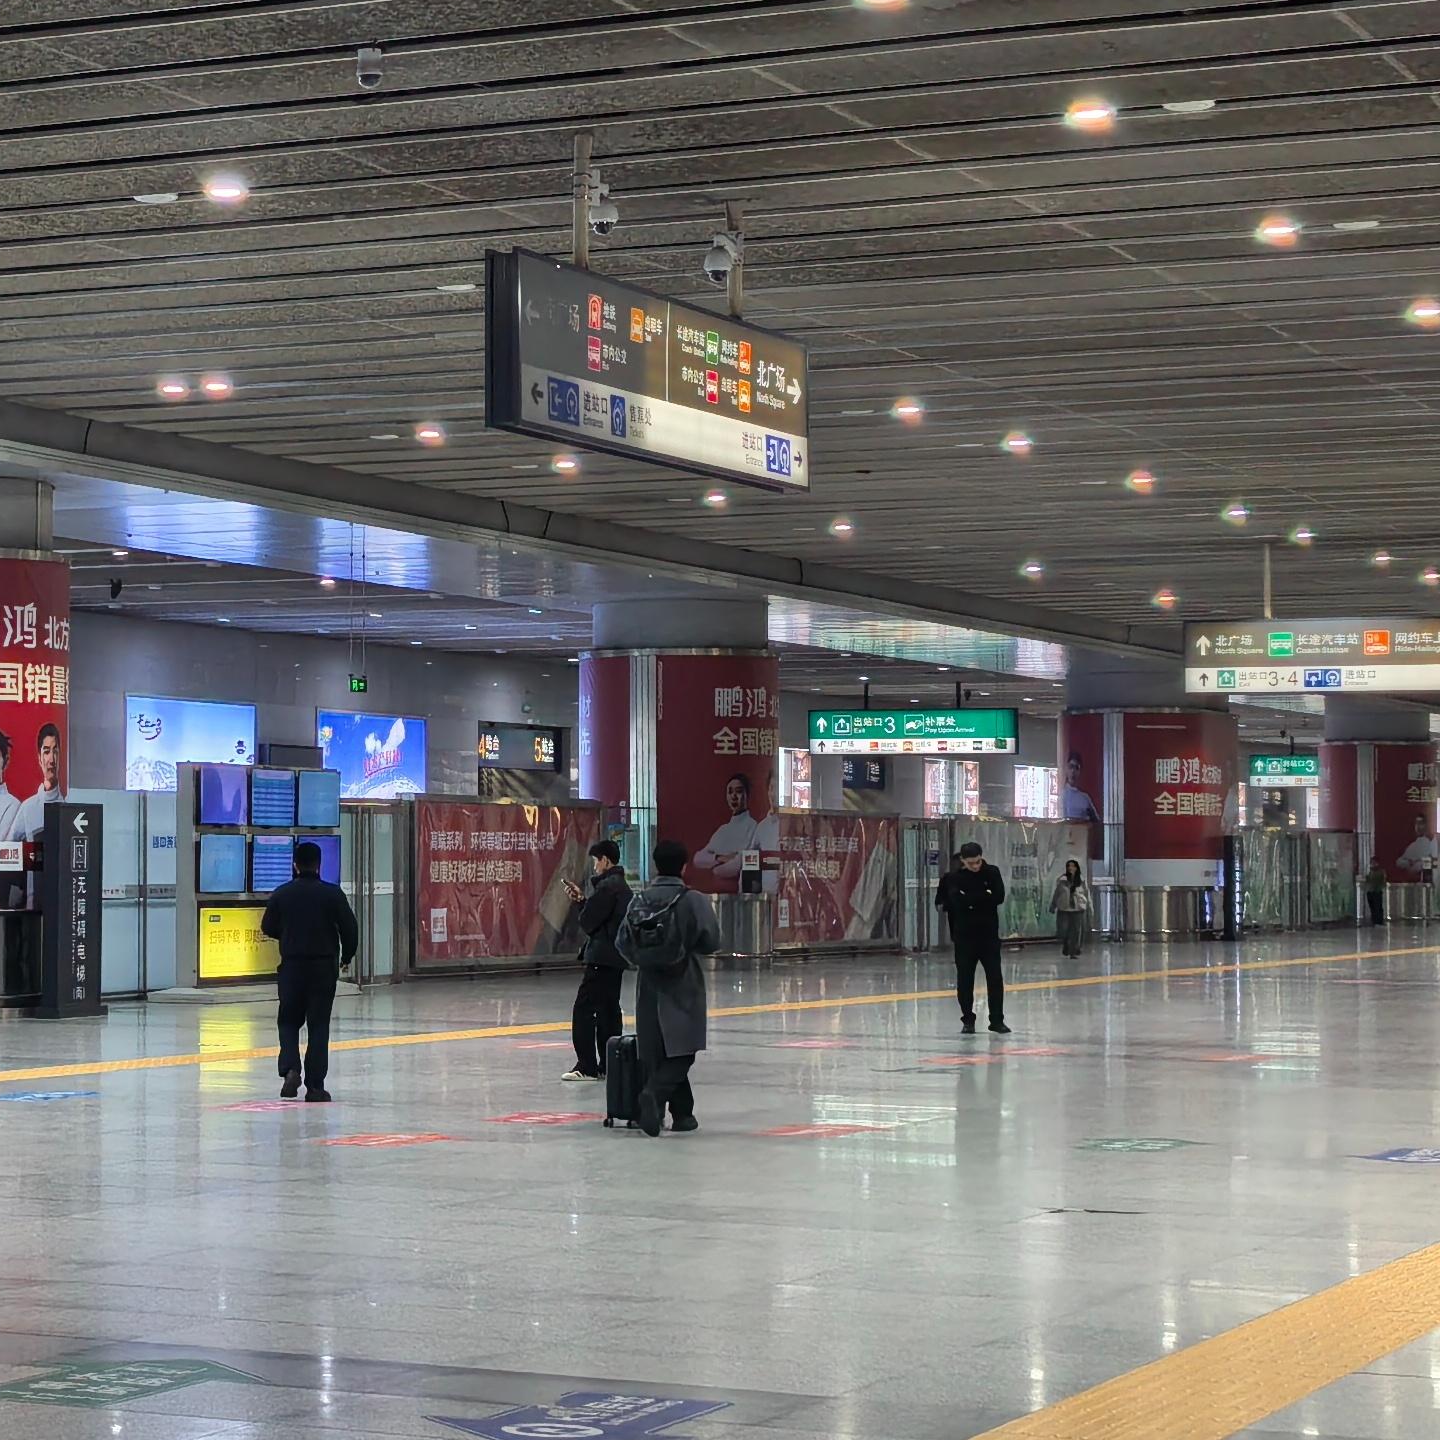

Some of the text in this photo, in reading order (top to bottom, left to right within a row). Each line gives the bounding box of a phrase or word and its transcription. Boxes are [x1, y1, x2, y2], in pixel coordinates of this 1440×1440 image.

[602, 344, 627, 365] 市内公交
[681, 365, 705, 386] 市内公交
[756, 359, 786, 393] 北广场
[583, 390, 609, 416] 进站口
[1215, 634, 1254, 646] 北广场
[1296, 633, 1360, 646] 长途汽车站
[1395, 644, 1440, 653] Ride-Hailing
[1215, 646, 1264, 656] North Square
[1296, 646, 1349, 655] Coach Station
[1238, 671, 1267, 681] 出站口
[1344, 669, 1377, 680] 进站口
[714, 685, 767, 719] 鹏鸿
[853, 716, 956, 734] 出站口 3 补票处
[479, 733, 486, 760] 4
[534, 737, 542, 762] 5
[712, 726, 779, 756] 全国销
[1155, 757, 1200, 784] 鹏鸿
[1305, 759, 1314, 772] 3
